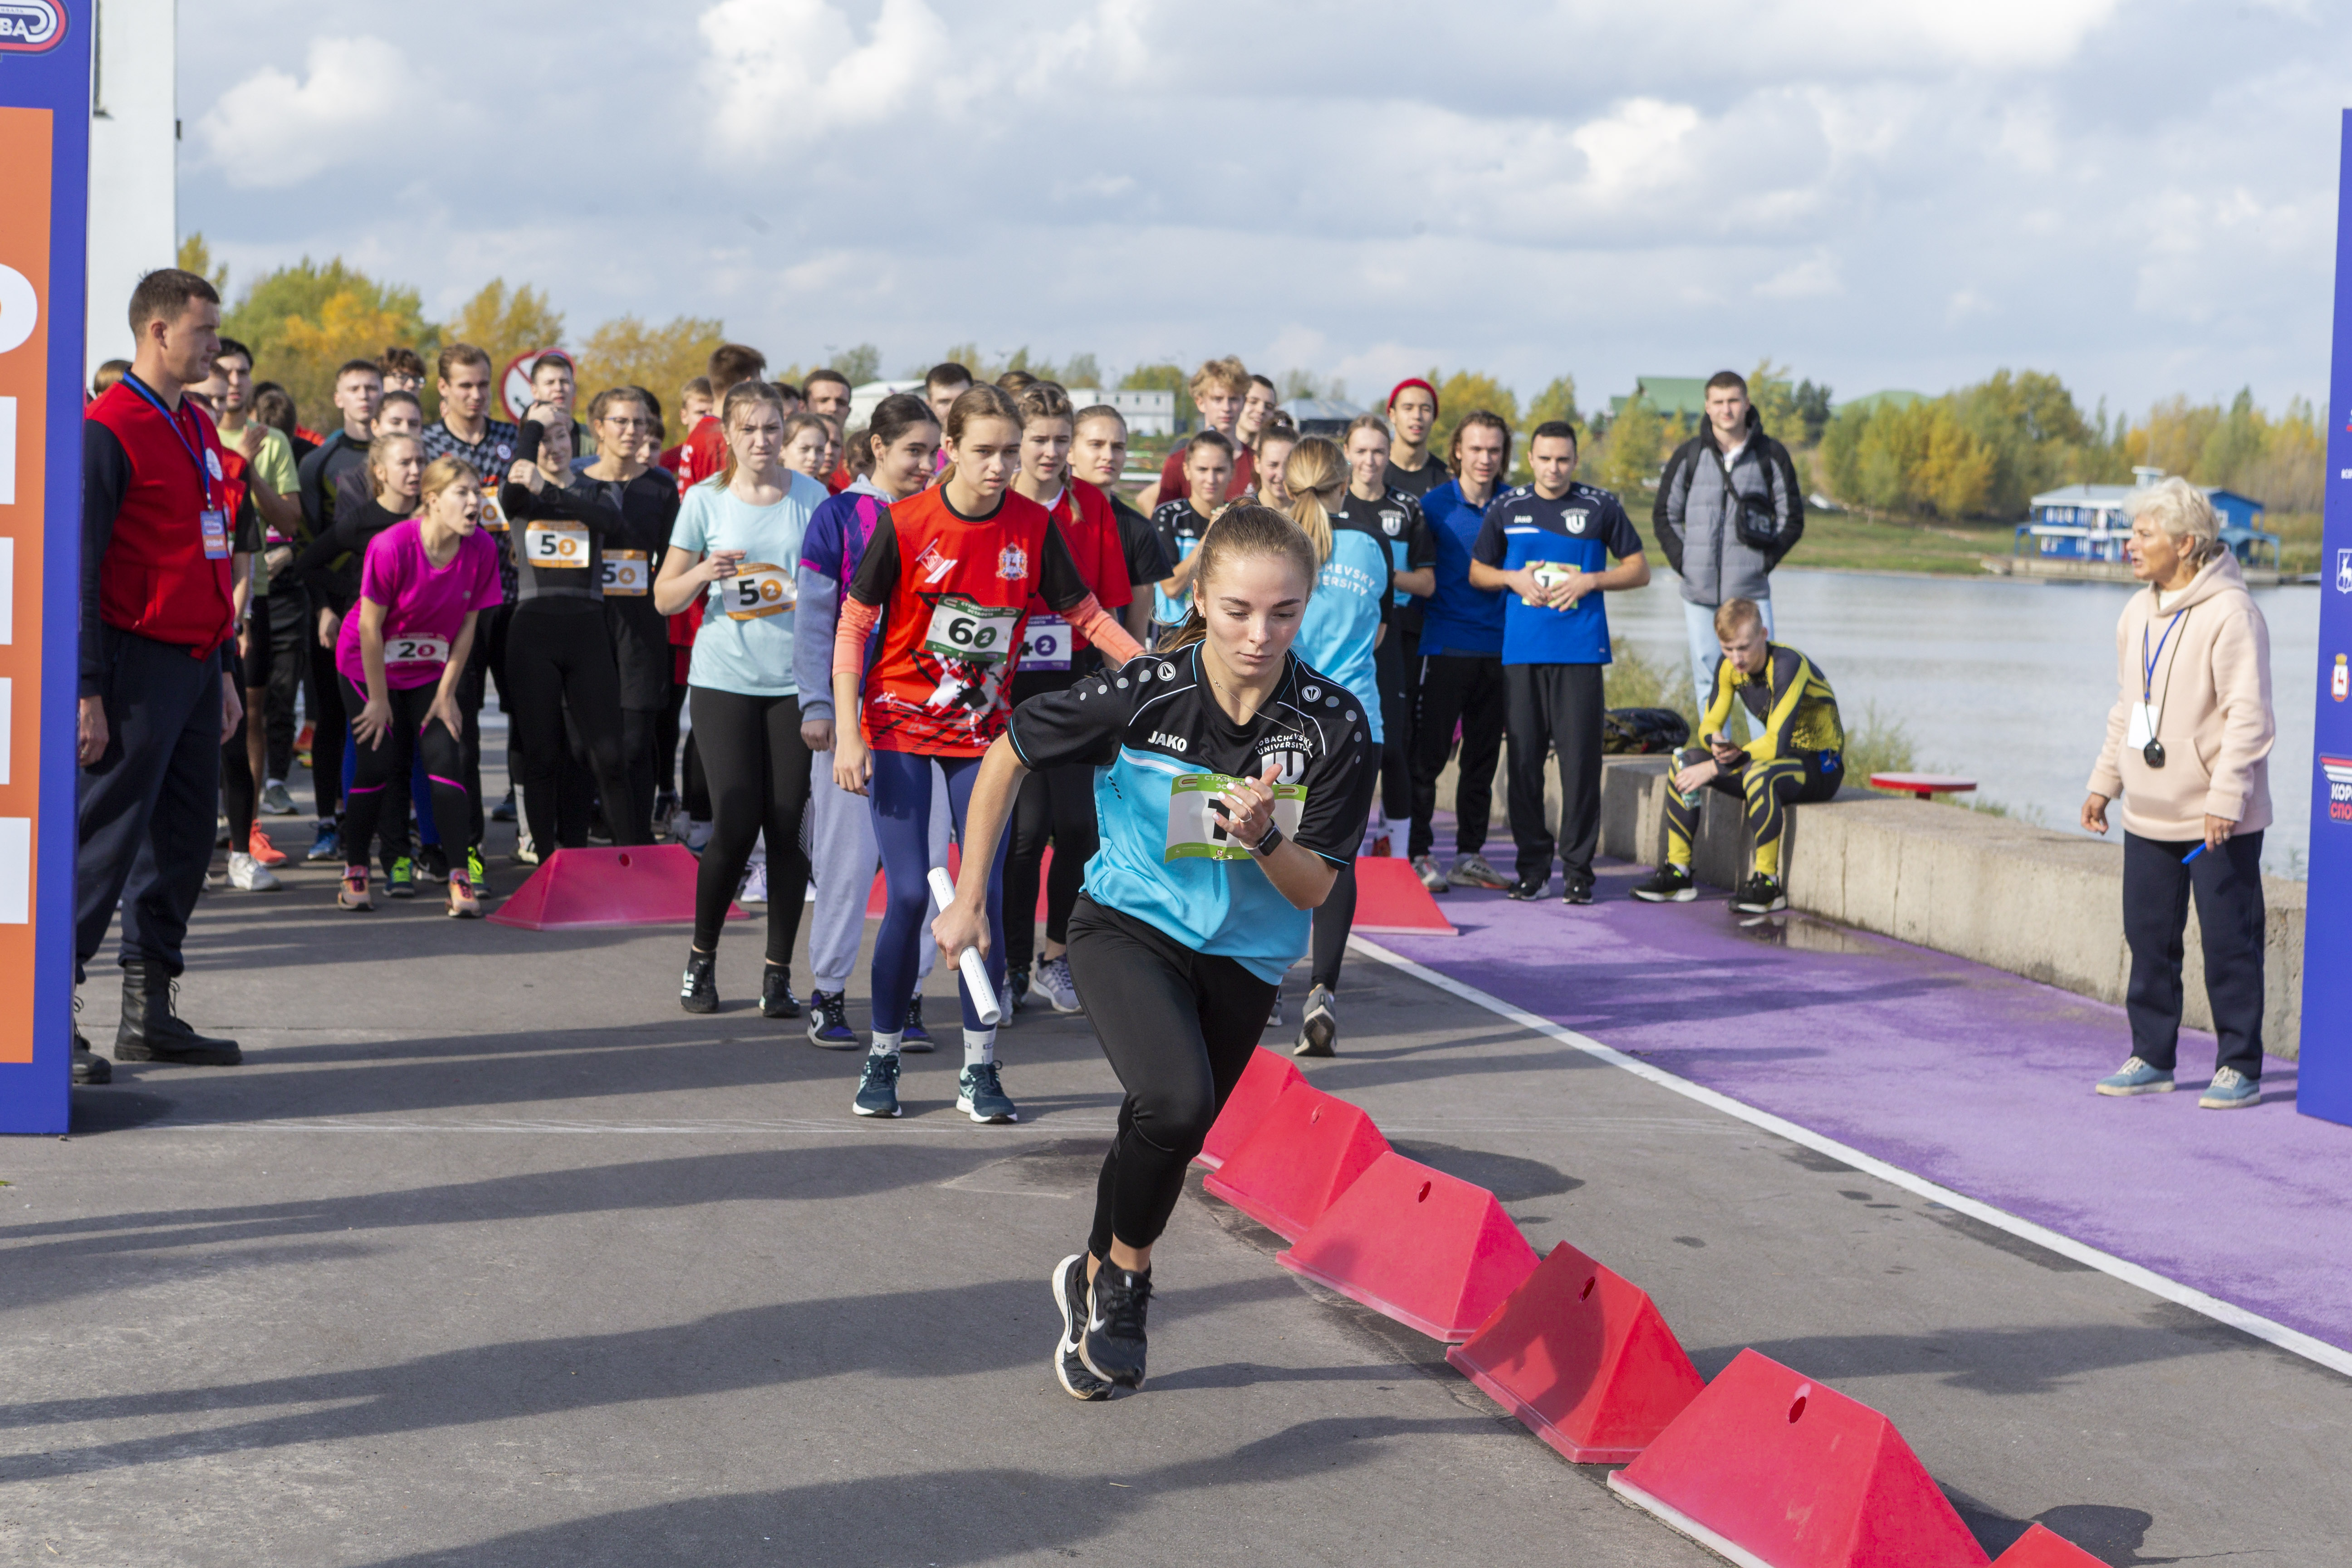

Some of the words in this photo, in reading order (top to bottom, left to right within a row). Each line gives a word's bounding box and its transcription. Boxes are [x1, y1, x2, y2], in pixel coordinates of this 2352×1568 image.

[1319, 563, 1375, 588] HEVSKY
[739, 578, 760, 605] 5
[949, 617, 976, 645] 6
[1148, 731, 1187, 752] JAKO
[1257, 742, 1308, 755] UNIVERSITY
[2331, 783, 2352, 801] КОР
[1208, 799, 1230, 841] 1
[2330, 802, 2352, 820] СПО
